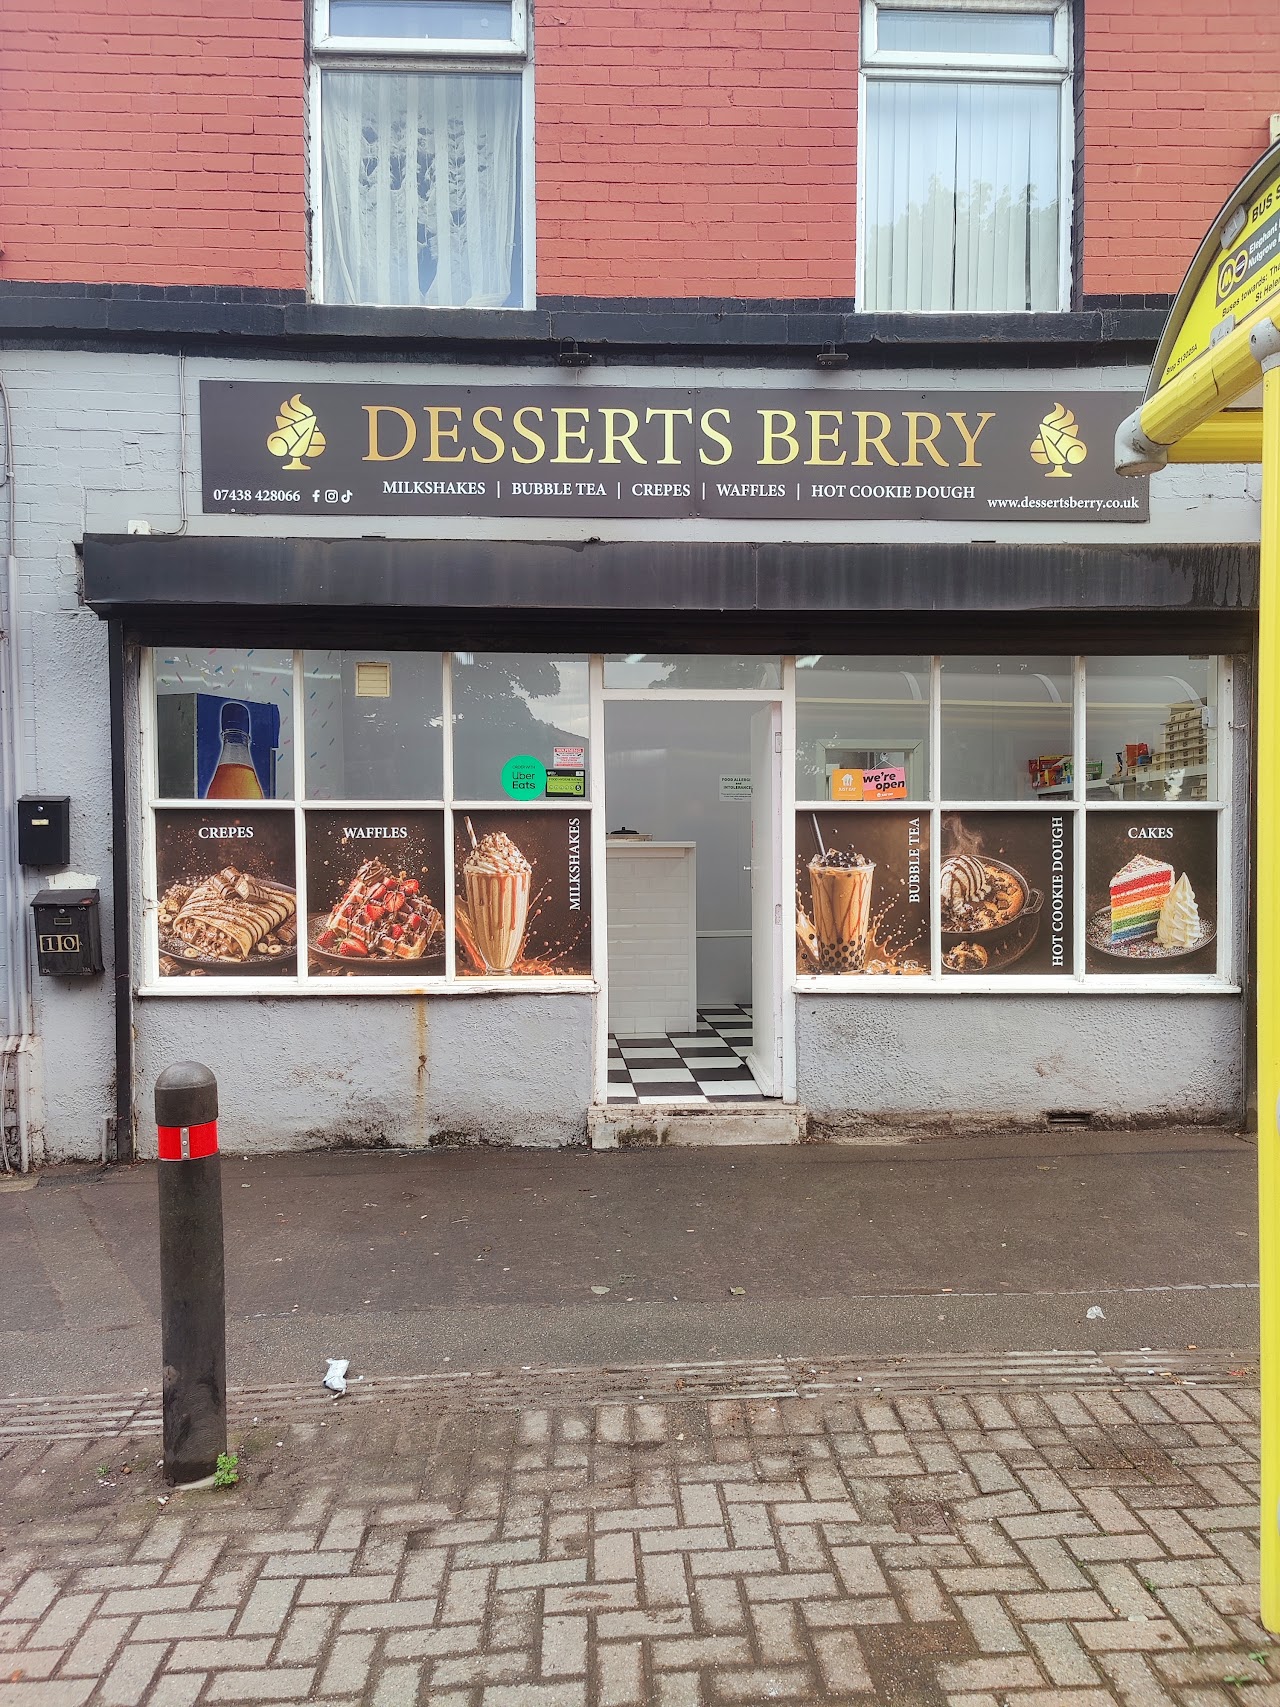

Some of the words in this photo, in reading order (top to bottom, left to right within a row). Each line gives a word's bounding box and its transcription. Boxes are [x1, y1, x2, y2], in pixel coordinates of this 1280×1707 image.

[1252, 193, 1272, 223] BUS
[1249, 222, 1278, 255] Elephant
[1248, 238, 1277, 269] Nutgrove
[1255, 290, 1262, 302] St
[1222, 298, 1240, 318] Buses
[361, 405, 733, 466] DESSERTS
[756, 409, 996, 467] BERRY
[213, 488, 252, 502] 07438
[254, 489, 301, 502] 428066
[382, 480, 486, 495] MILKSHAKES
[511, 482, 573, 496] BUBBLE
[575, 482, 608, 496] TEA
[631, 483, 691, 497] CREPES
[715, 483, 786, 497] WAFFLES
[811, 484, 847, 498] HOT
[849, 484, 912, 499] COOKIE
[915, 485, 976, 499] DOUGH
[986, 495, 1140, 512] www.dessertsberry.co.uk
[512, 772, 535, 780] Uber
[512, 781, 536, 789] Eats
[863, 771, 896, 783] we're
[875, 780, 905, 791] open
[198, 827, 254, 840] CREPES
[343, 827, 408, 840] WAFFLES
[908, 817, 921, 846] TEA
[1127, 827, 1174, 839] CAKES
[1052, 816, 1064, 872] DOUGH
[568, 817, 581, 911] MILKSHAKES
[908, 849, 921, 903] BUBBLE
[1052, 874, 1064, 932] COOKIE
[46, 937, 75, 950] 10
[1052, 934, 1064, 967] HOT
